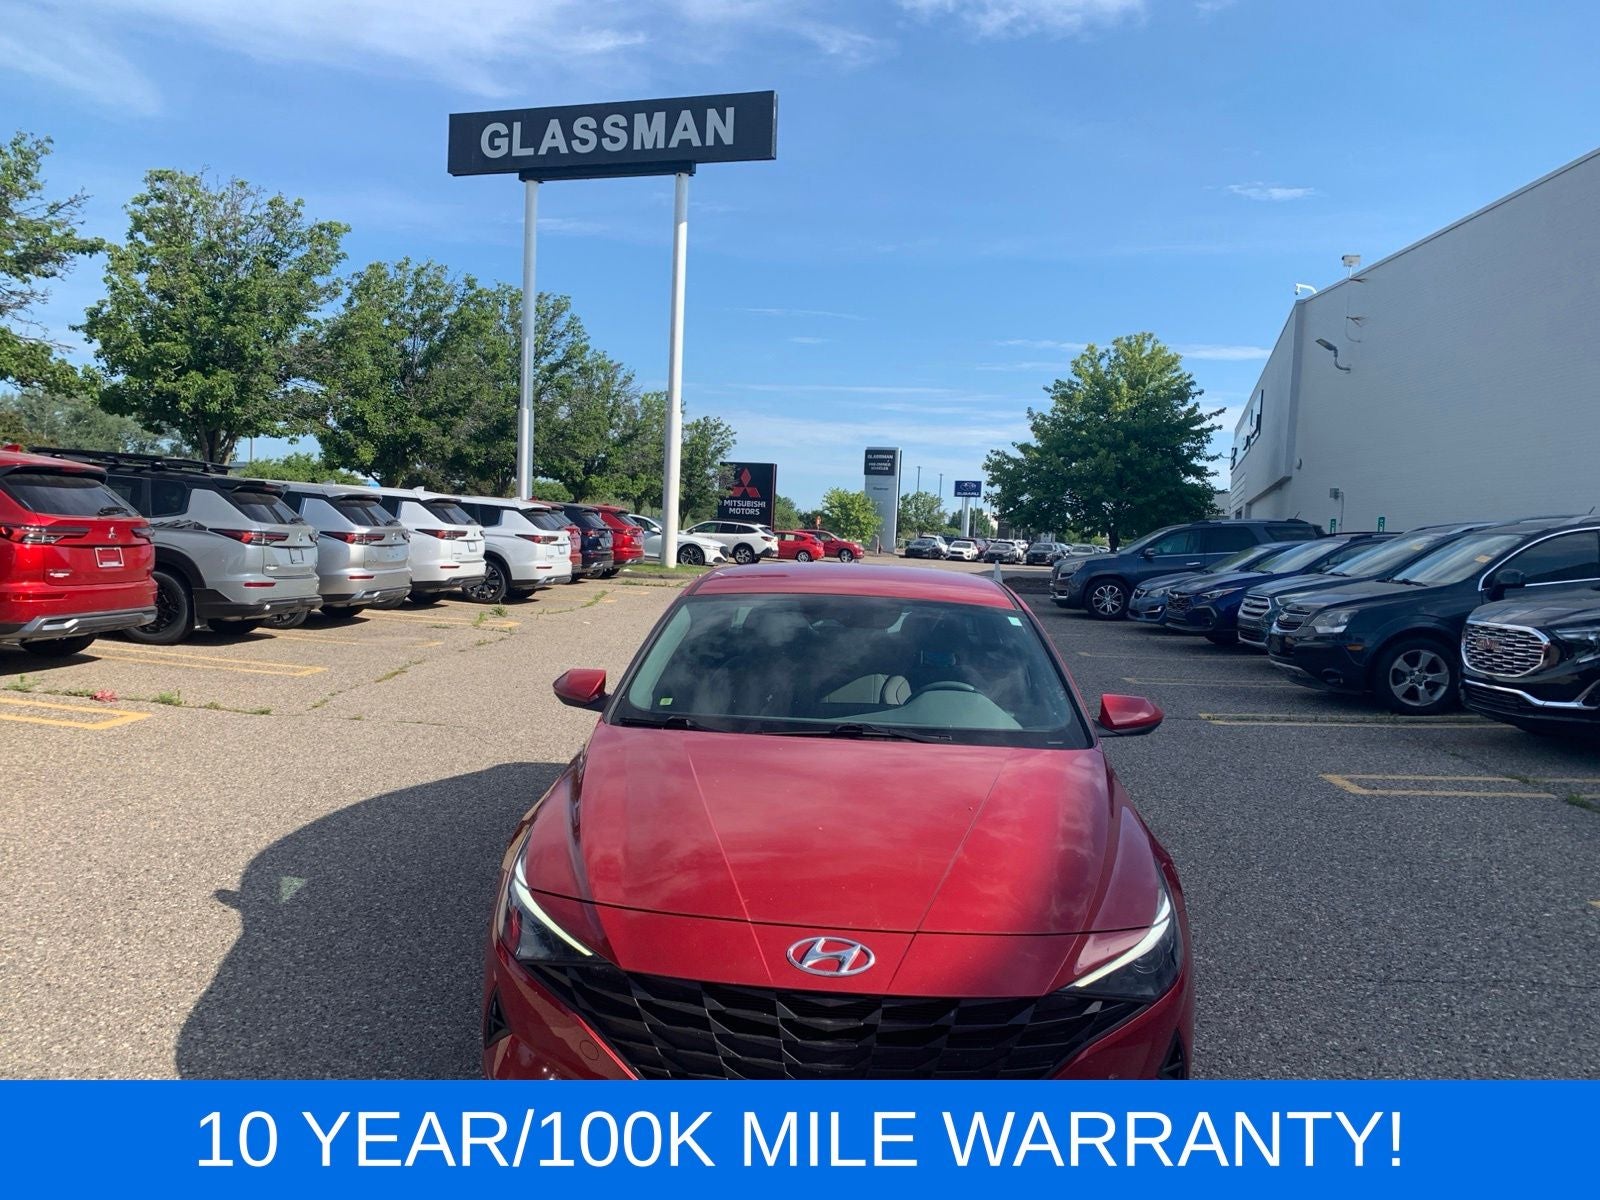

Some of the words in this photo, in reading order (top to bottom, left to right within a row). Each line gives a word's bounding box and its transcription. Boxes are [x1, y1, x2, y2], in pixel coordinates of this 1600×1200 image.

[480, 107, 735, 159] GLASSMAN
[723, 499, 766, 508] MITSUBISHI
[728, 507, 760, 516] MOTORS
